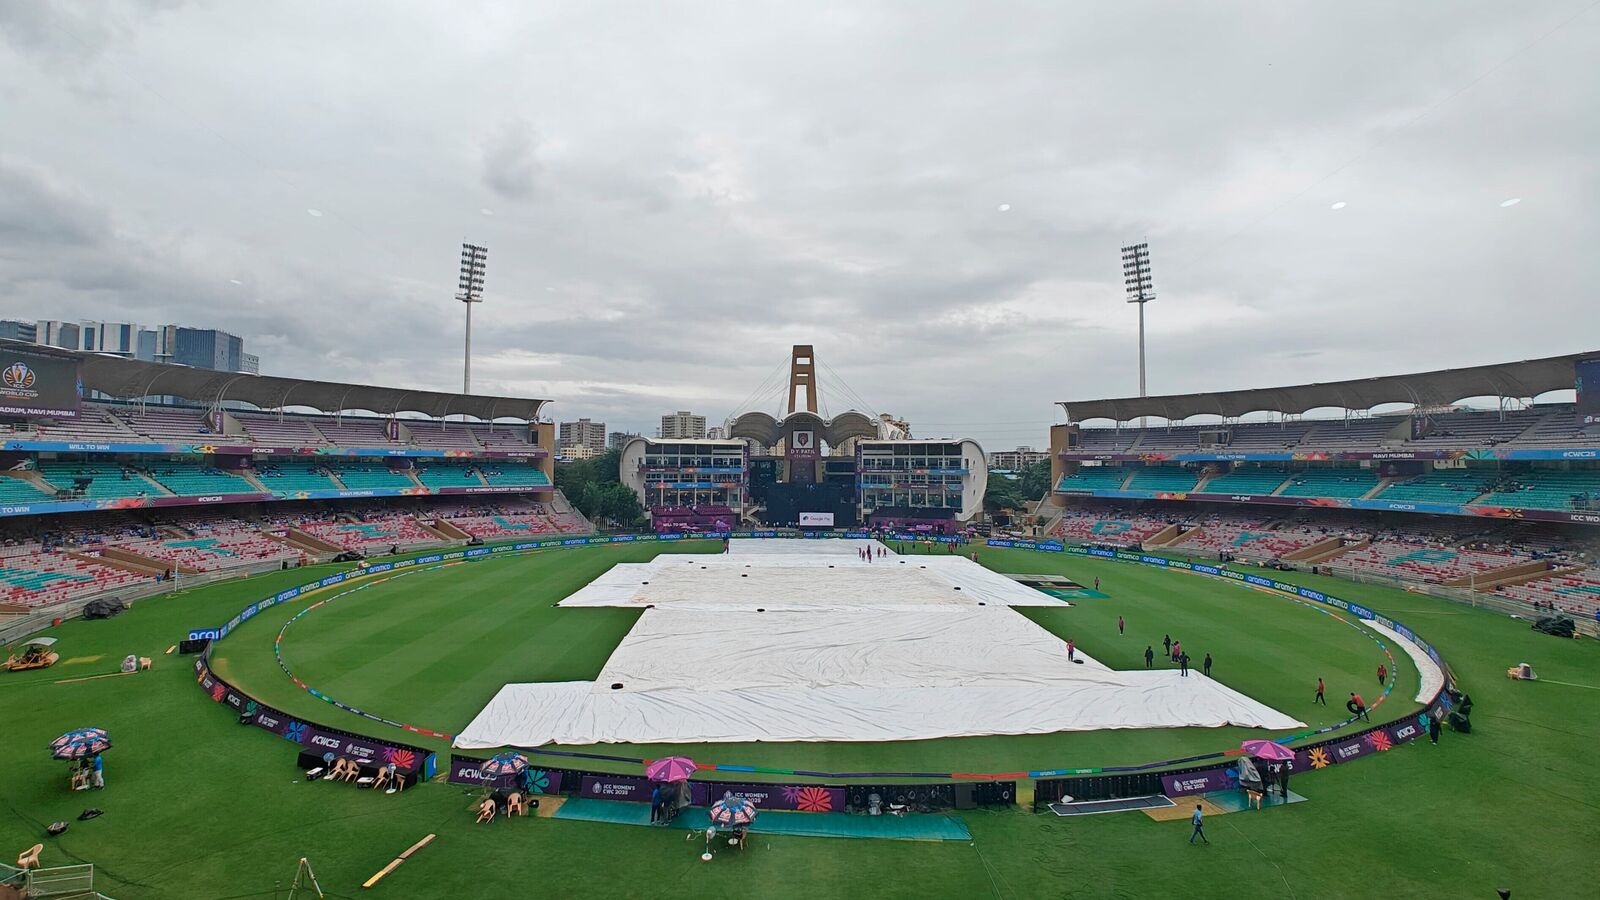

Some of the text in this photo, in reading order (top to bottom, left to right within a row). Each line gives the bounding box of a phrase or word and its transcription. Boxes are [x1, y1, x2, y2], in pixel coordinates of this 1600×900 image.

[369, 564, 390, 573] aramco
[394, 560, 415, 568] aramco
[1195, 565, 1217, 574] aramco
[346, 569, 366, 579] aramco
[1221, 570, 1244, 579] aramco
[323, 575, 342, 585] aramco
[1248, 576, 1270, 586] aramco
[300, 582, 320, 593] aramco
[1274, 582, 1297, 593] aramco
[278, 589, 298, 602] aramco
[1302, 589, 1323, 600] aramco
[258, 597, 275, 610] aramco
[1327, 597, 1348, 608] aramco
[1352, 605, 1371, 619] aramco
[1375, 615, 1394, 628] aramco
[312, 735, 340, 748] #CWC25
